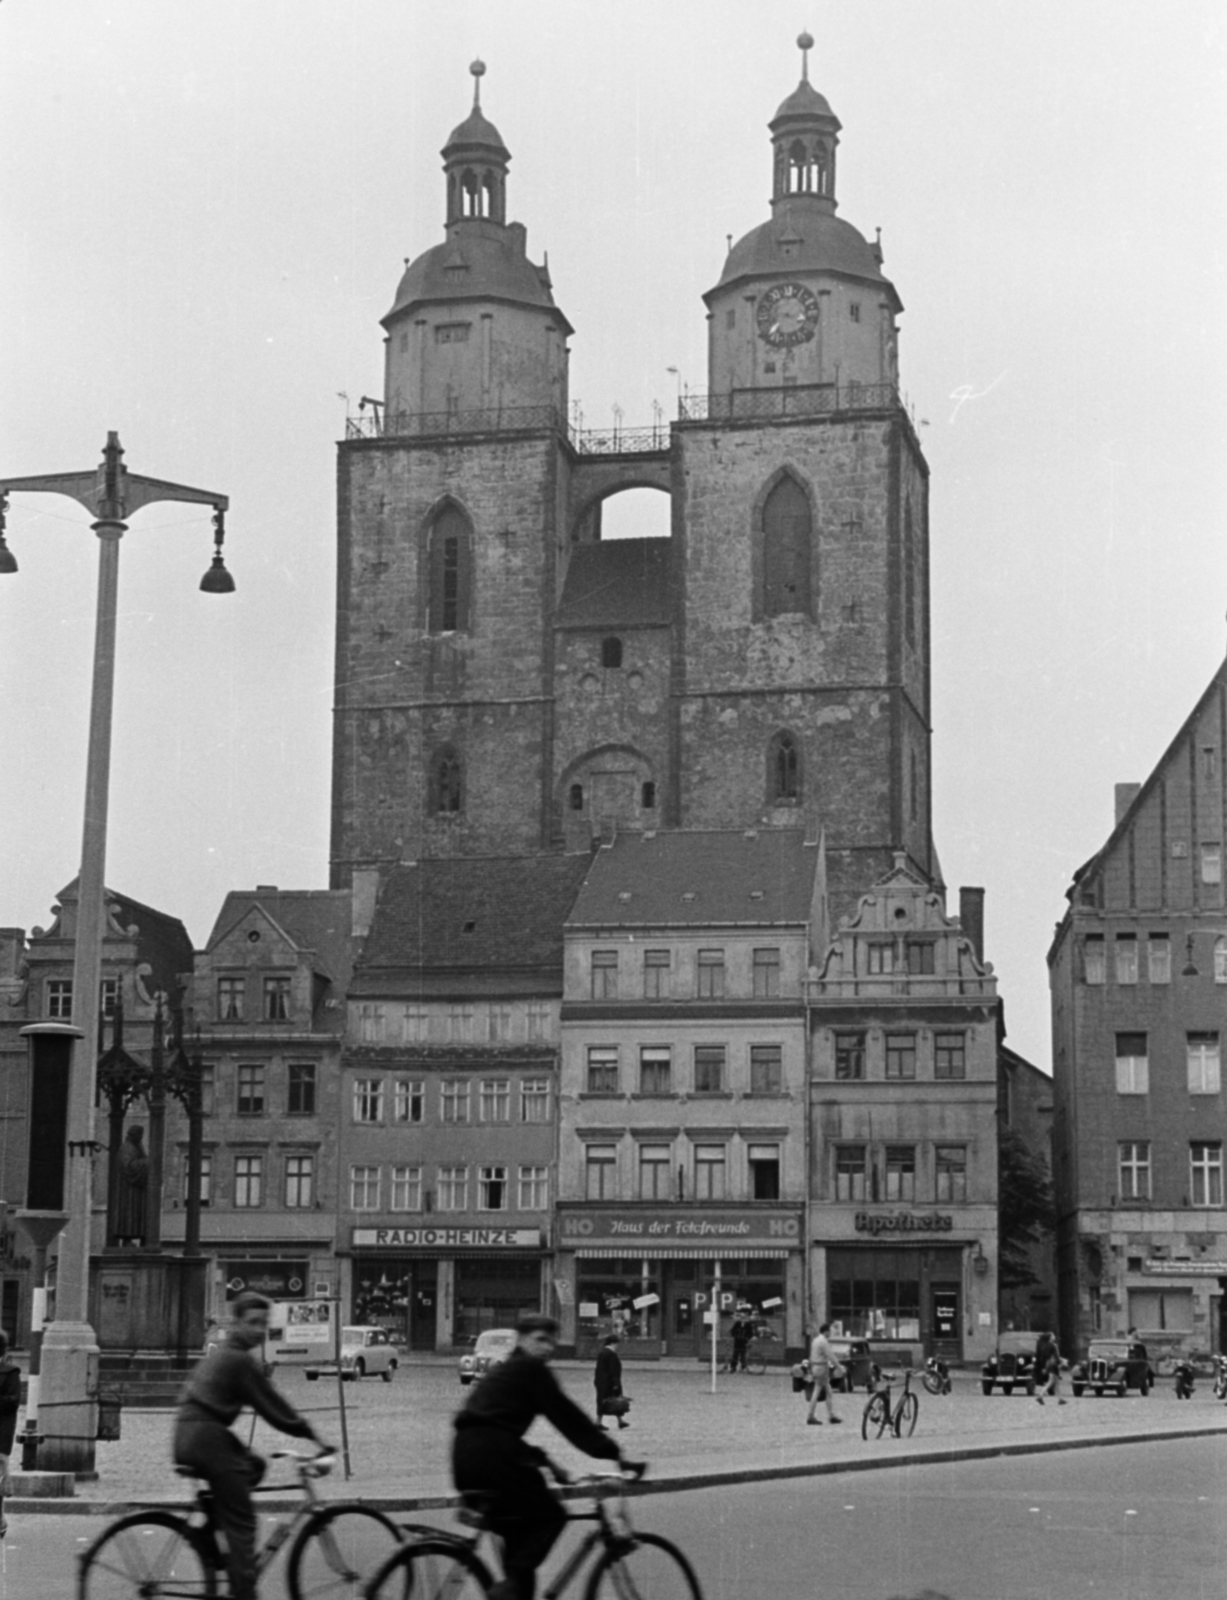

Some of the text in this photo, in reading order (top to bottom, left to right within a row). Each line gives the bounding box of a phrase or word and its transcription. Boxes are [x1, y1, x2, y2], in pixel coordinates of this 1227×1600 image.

[564, 1219, 594, 1234] HO
[610, 1220, 751, 1235] Haus der Fotofreunde
[769, 1219, 798, 1235] HO
[376, 1229, 518, 1244] RADIO-HEINZE
